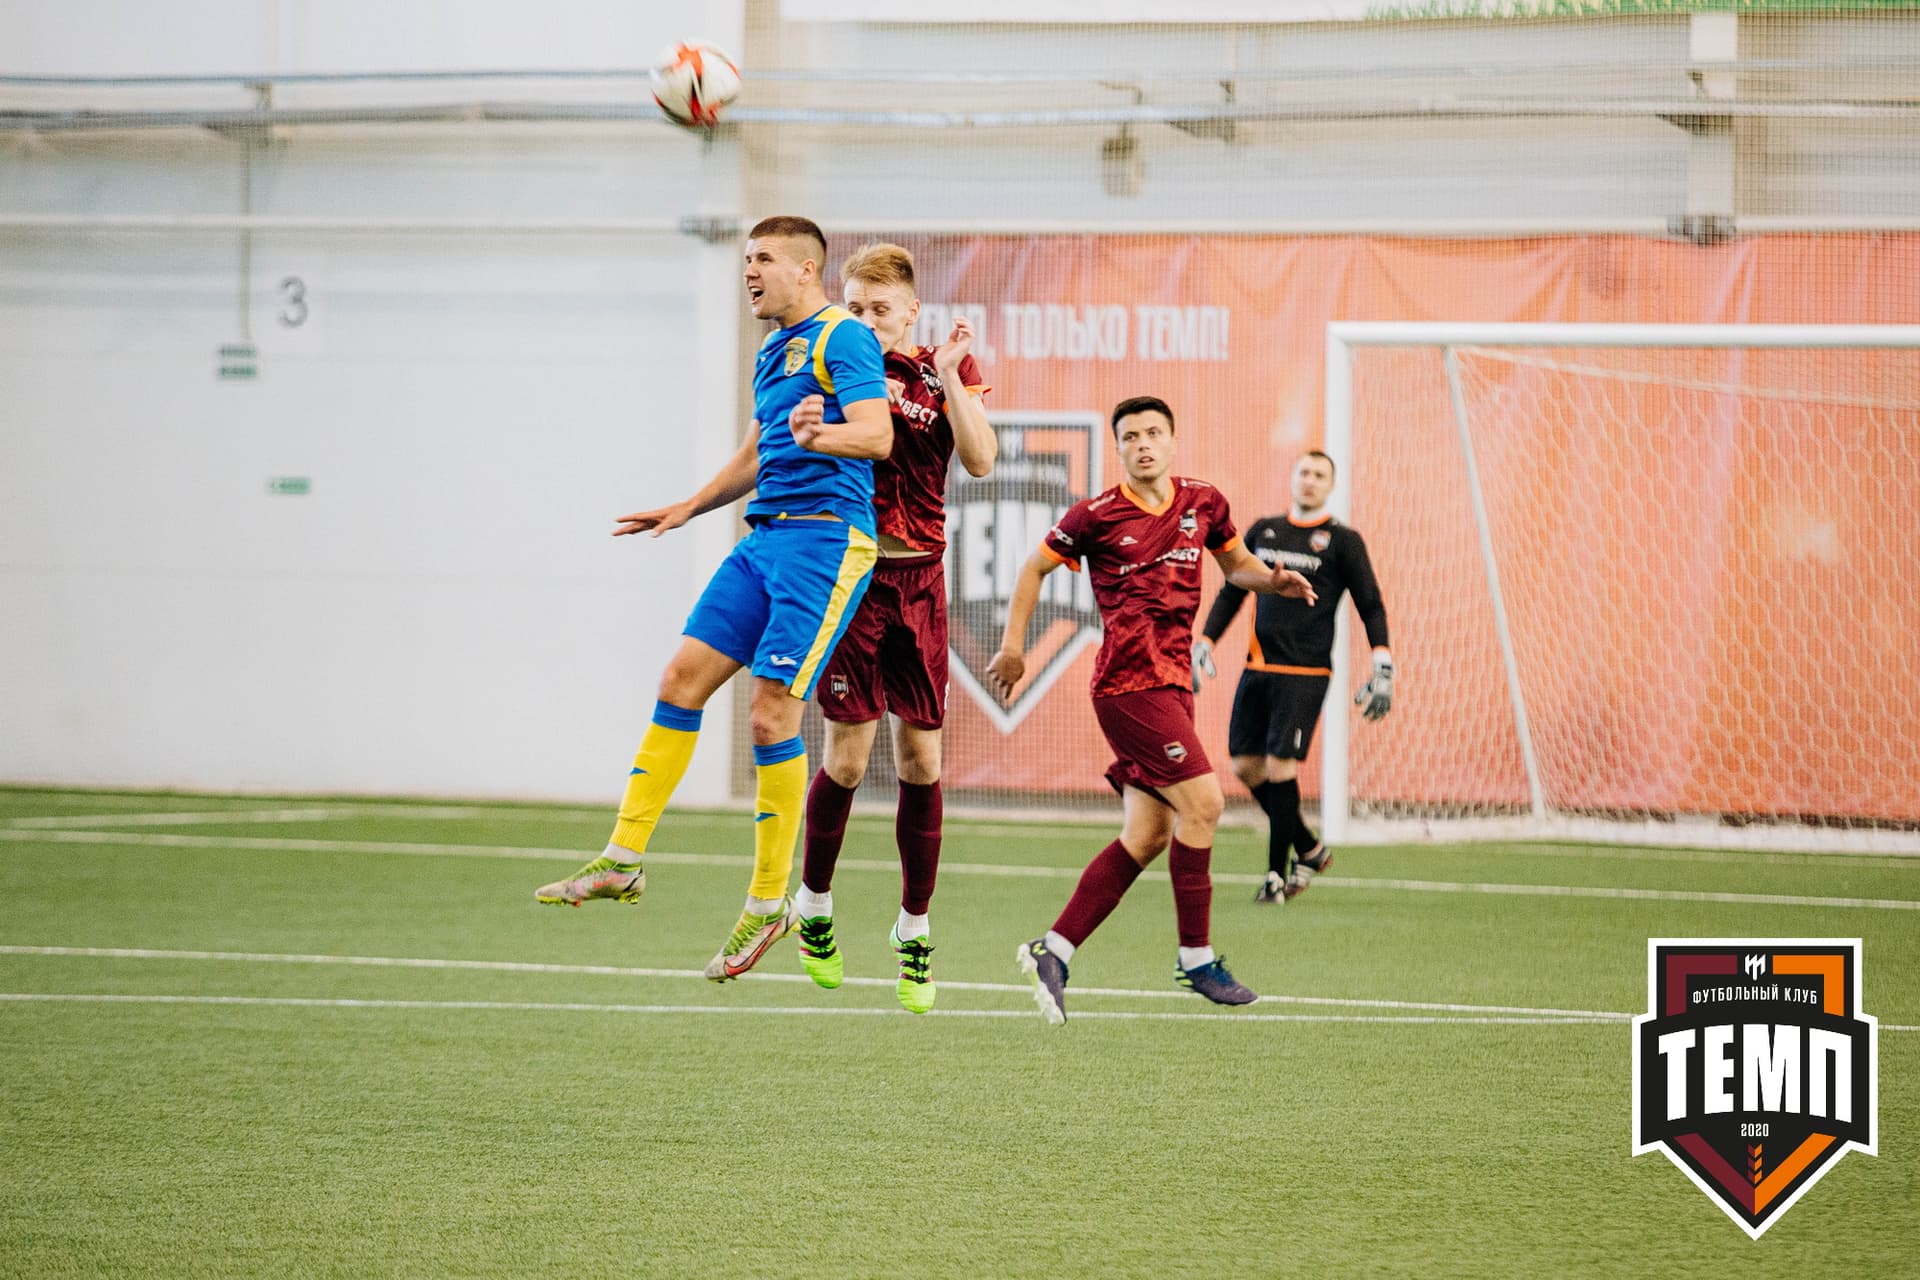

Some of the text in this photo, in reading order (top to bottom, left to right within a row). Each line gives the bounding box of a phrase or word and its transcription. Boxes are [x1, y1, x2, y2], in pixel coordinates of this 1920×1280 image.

[279, 276, 308, 328] 3
[1004, 303, 1128, 361] ТОЛЬКО
[1135, 306, 1229, 361] ТЕМП!
